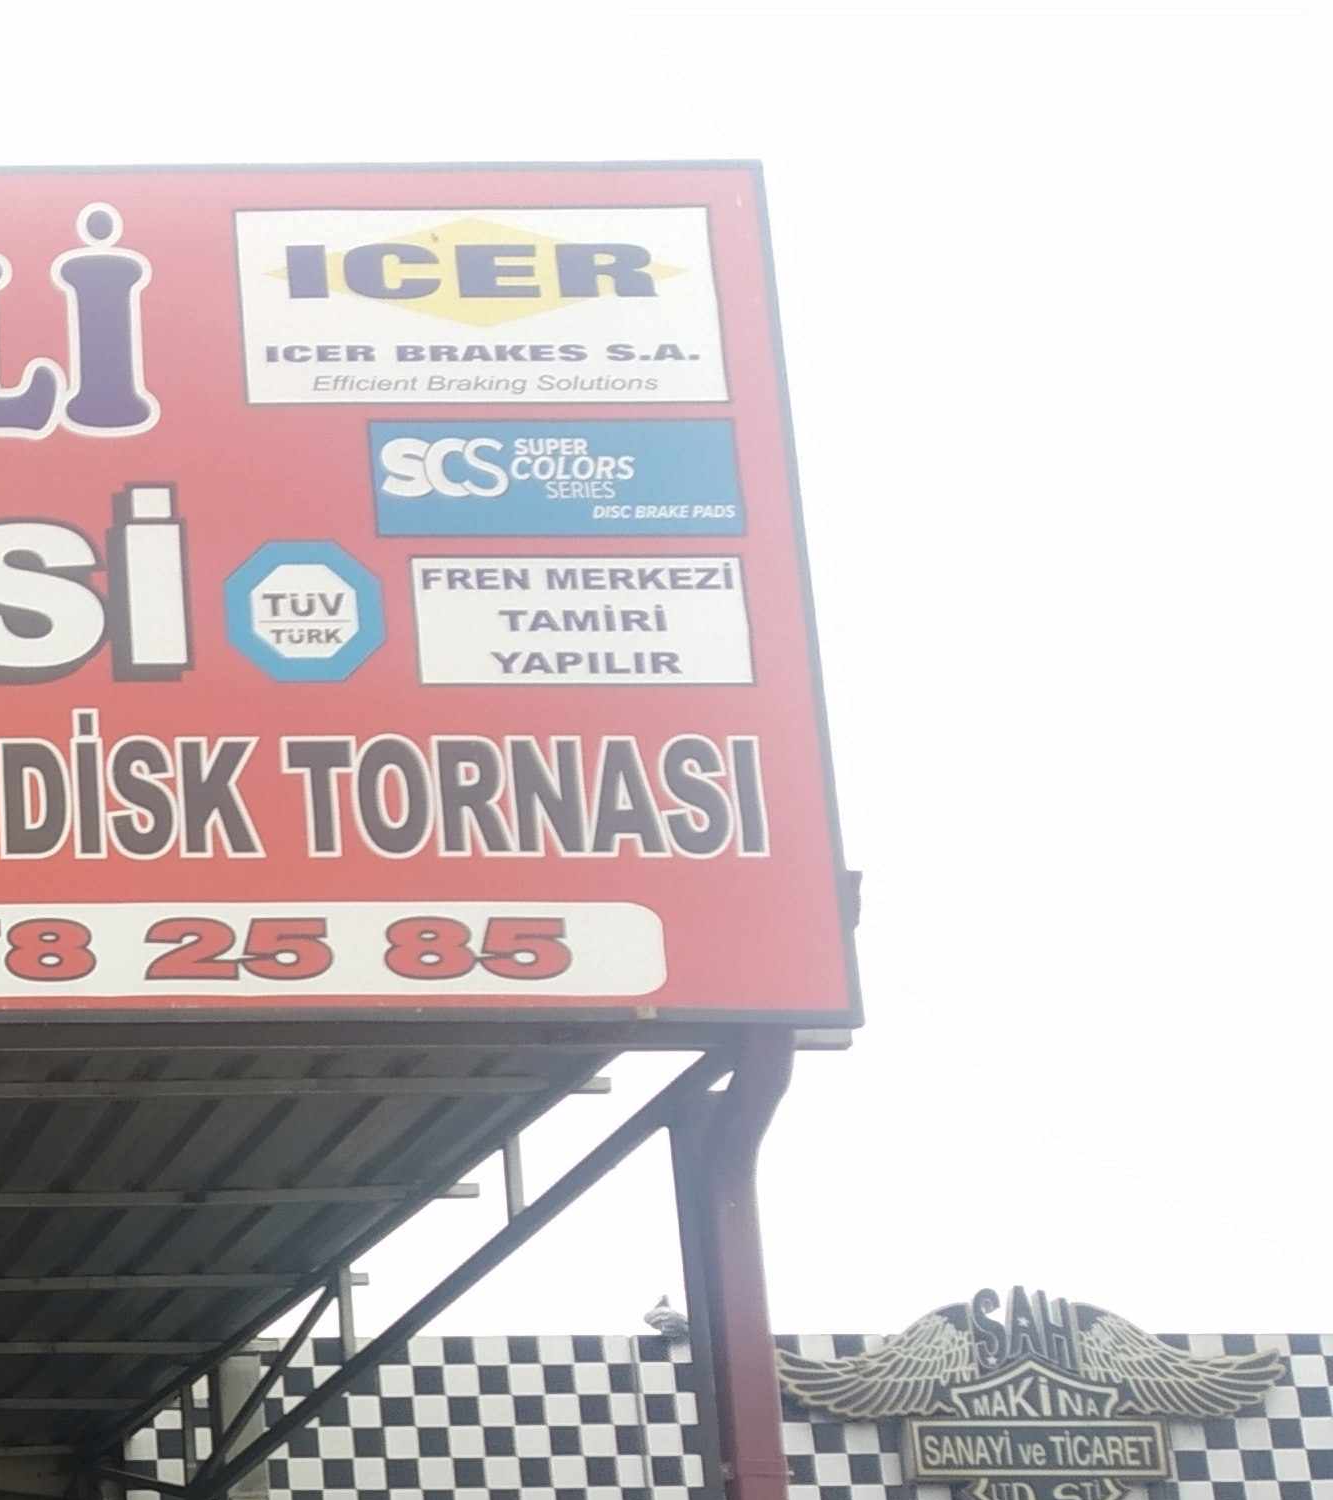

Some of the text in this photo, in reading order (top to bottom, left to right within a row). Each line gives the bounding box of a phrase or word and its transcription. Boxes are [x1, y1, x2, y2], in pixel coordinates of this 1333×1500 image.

[284, 243, 659, 299] ICER
[266, 342, 700, 363] ICER BRAKES S.A.
[312, 372, 659, 397] Efficient Braking Solutions
[514, 437, 588, 457] SUPER
[380, 437, 510, 497] SCS
[510, 455, 635, 481] COLORS
[545, 479, 616, 500] SERIES
[591, 503, 736, 520] DISC BRAKE PADS
[421, 559, 735, 592] FREN MERKEZİ
[262, 591, 346, 618] TÜV
[499, 603, 667, 632] TAMİRİ
[270, 626, 344, 646] TÜRK
[489, 650, 682, 675] YAPILIR
[0, 708, 265, 860] DİSK
[281, 734, 770, 859] TORNASI
[144, 917, 334, 982] 25
[384, 916, 573, 980] 85
[972, 1377, 1100, 1418] MAKİNA
[922, 1427, 1153, 1468] SANAYİ ve TİCARET
